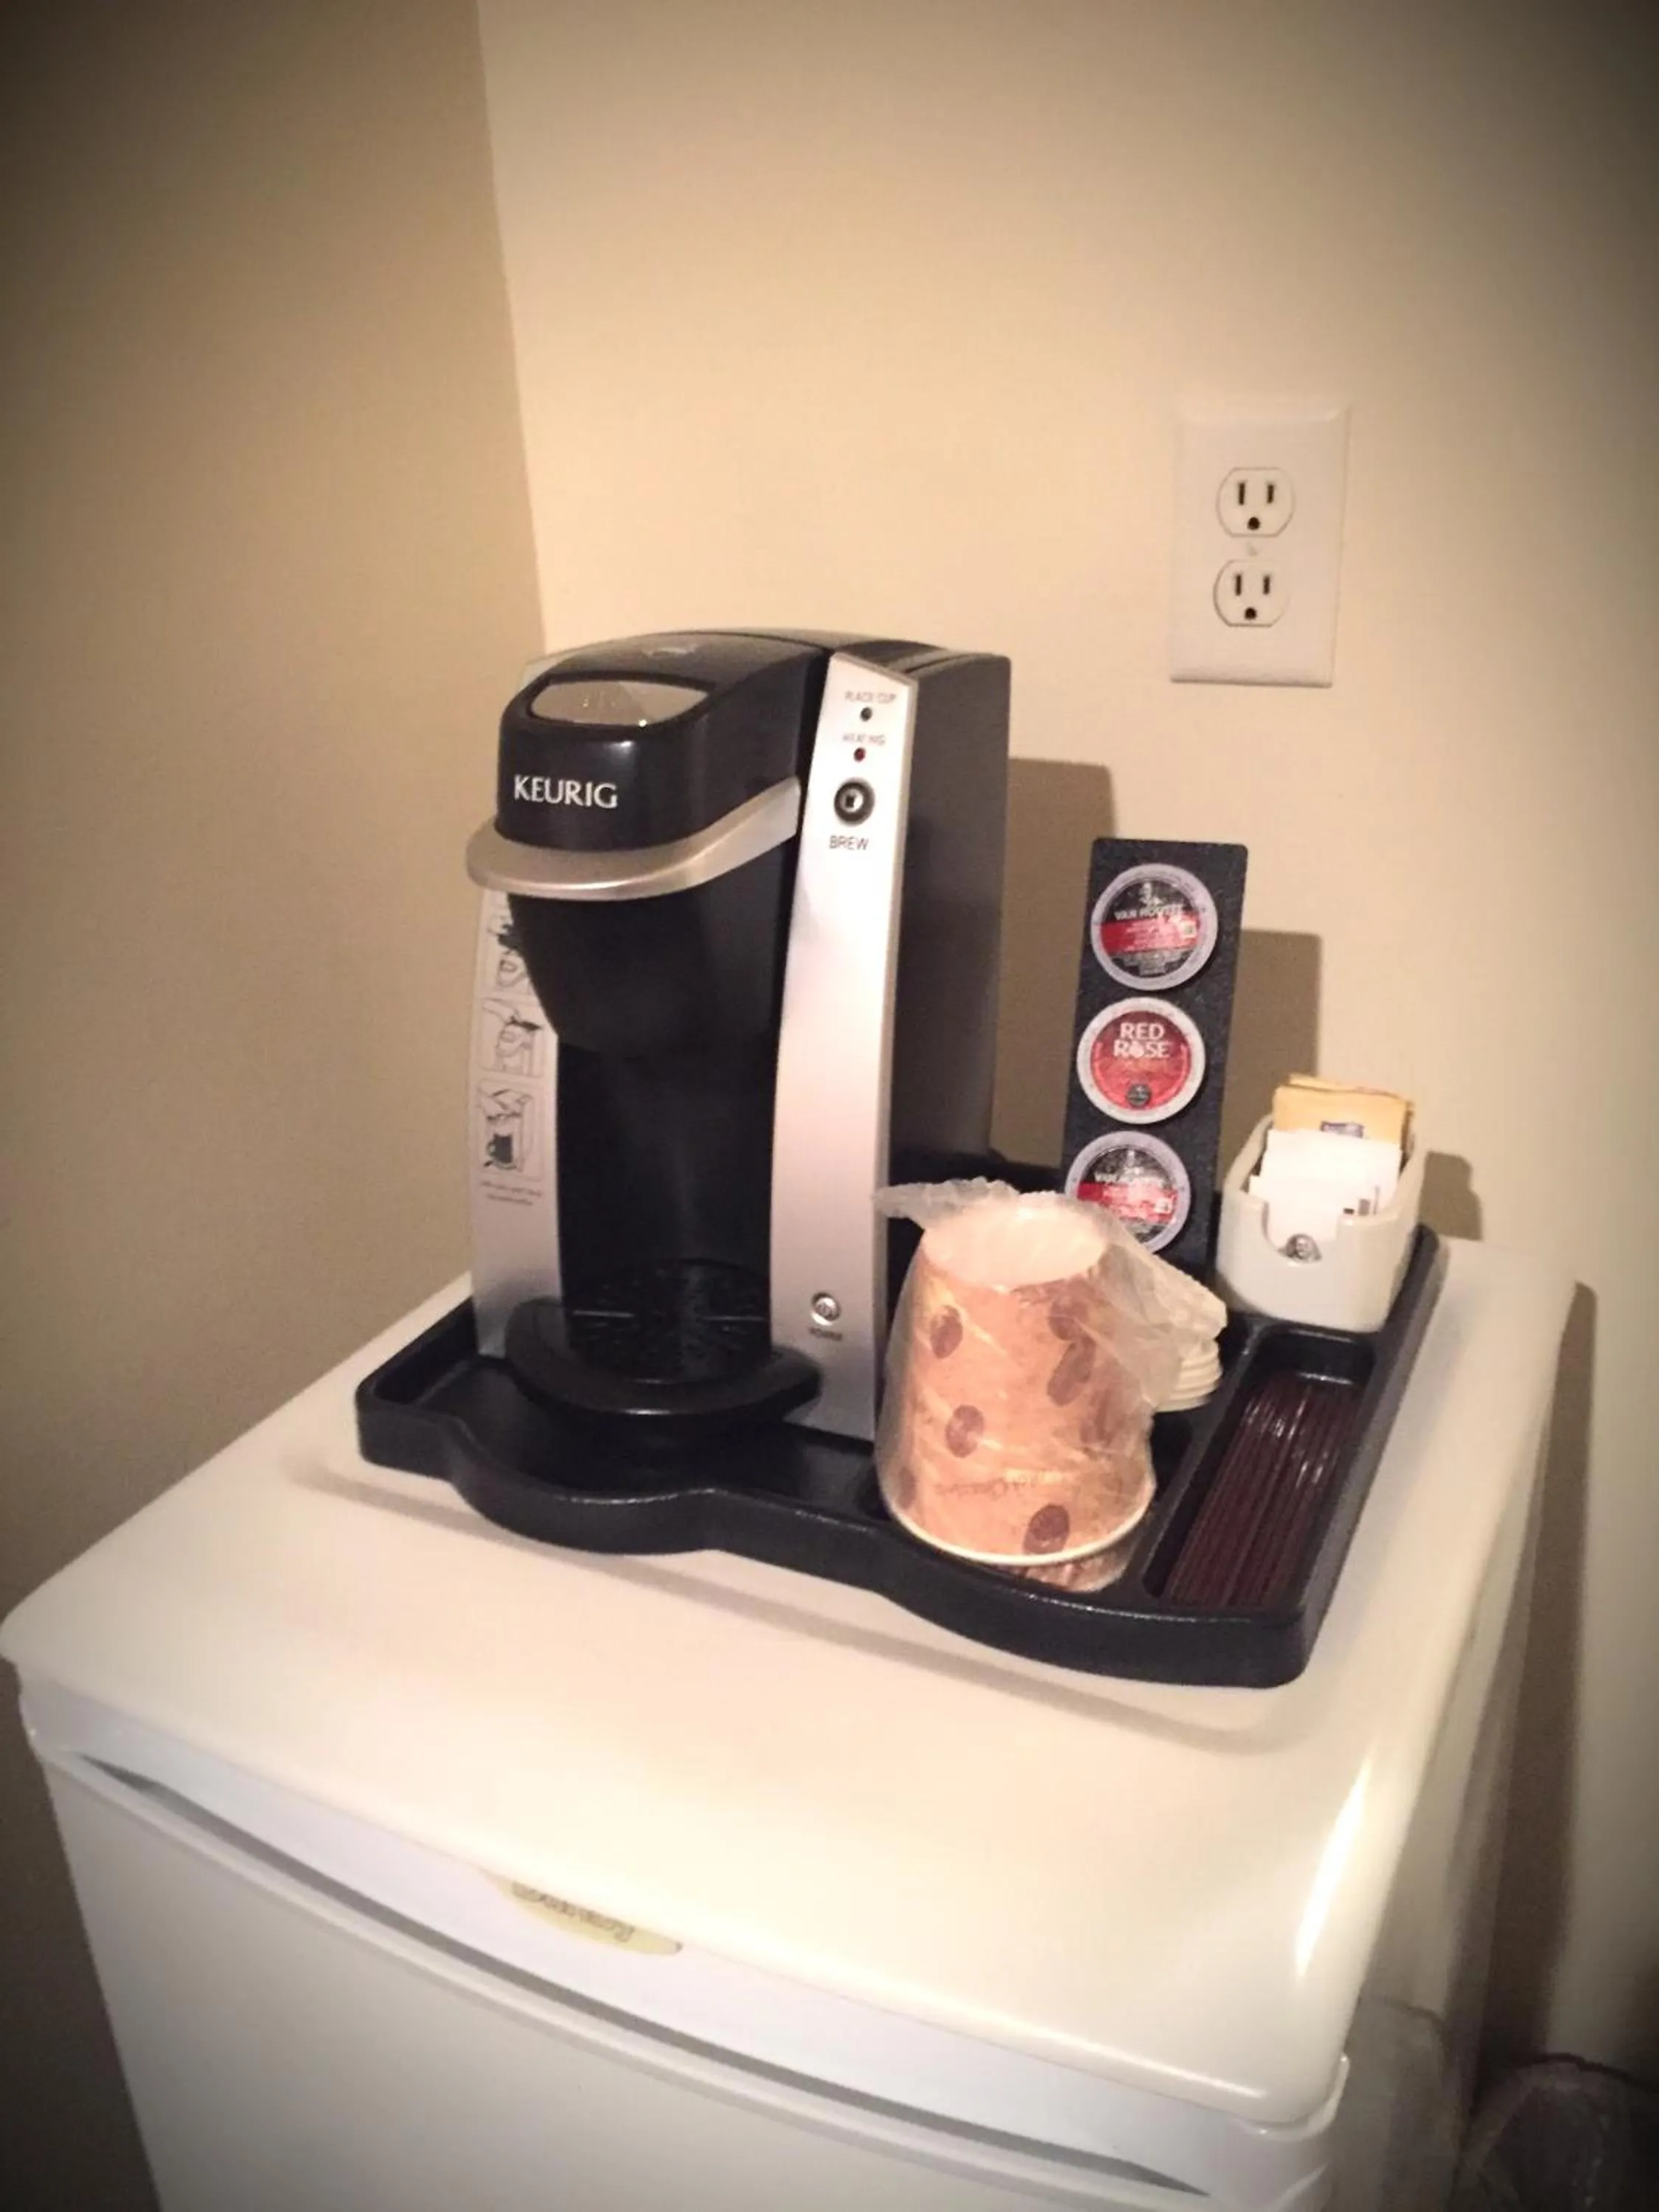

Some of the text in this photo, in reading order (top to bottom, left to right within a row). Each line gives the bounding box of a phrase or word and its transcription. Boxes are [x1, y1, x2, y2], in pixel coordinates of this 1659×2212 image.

[514, 774, 618, 809] KEURIG
[830, 835, 869, 850] BREW
[1120, 1022, 1166, 1040] RED
[1113, 1039, 1171, 1058] ROSE
